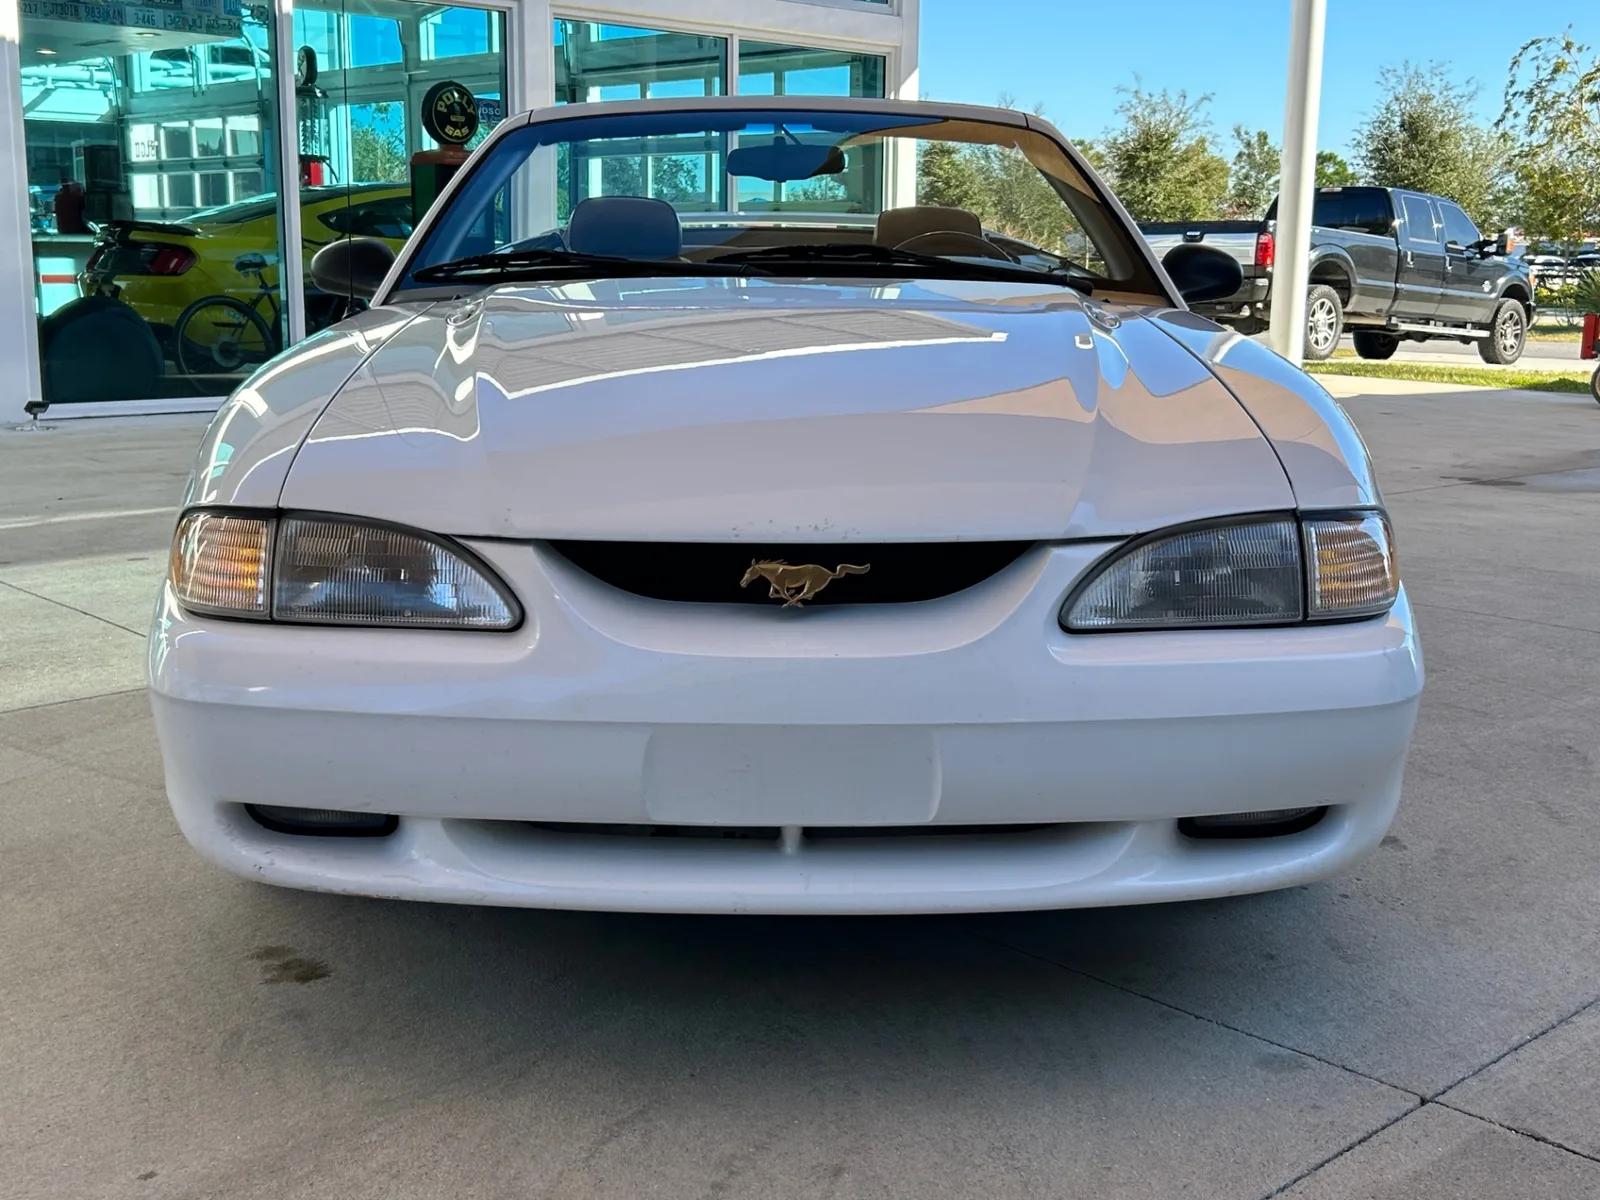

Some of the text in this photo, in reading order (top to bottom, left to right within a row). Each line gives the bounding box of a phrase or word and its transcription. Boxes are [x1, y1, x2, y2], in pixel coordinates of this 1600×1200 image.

[436, 90, 475, 114] POLLY
[479, 107, 501, 116] DSO
[444, 125, 469, 137] GAS
